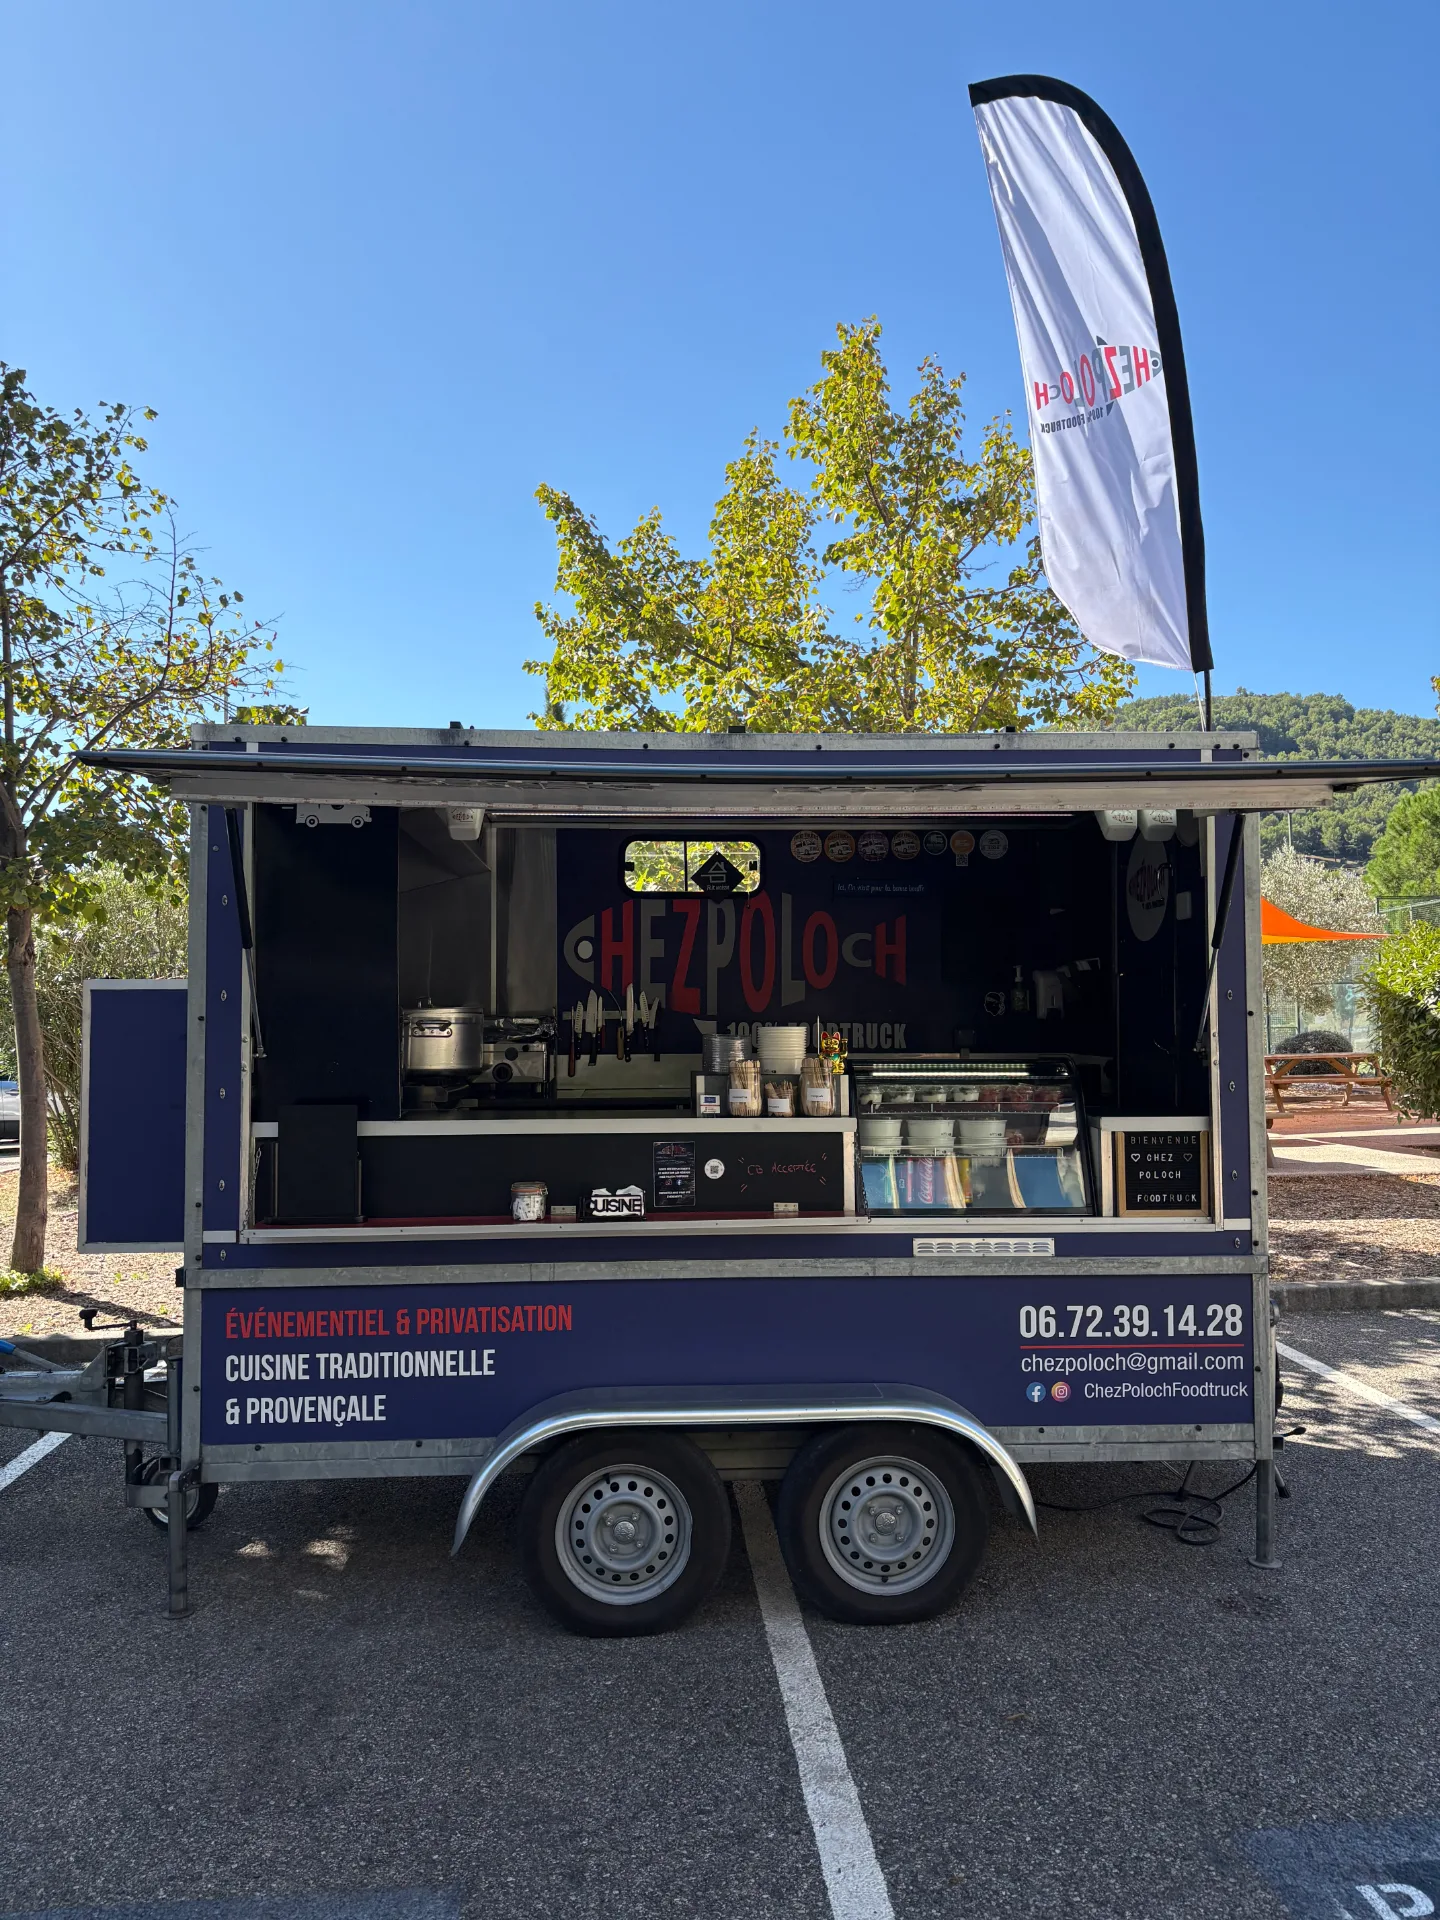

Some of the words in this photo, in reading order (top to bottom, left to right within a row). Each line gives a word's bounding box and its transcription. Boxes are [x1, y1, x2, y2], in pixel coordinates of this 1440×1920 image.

[1130, 1135, 1197, 1145] BIENVENUE
[1146, 1153, 1174, 1162] CHEZ
[747, 1164, 764, 1176] CB
[1139, 1170, 1181, 1180] POLOCH
[1137, 1194, 1197, 1203] FOODTRUCK
[225, 1307, 390, 1339] ÉVÉNEMENTIEL
[396, 1308, 411, 1336] &
[416, 1304, 573, 1335] PRIVATISATION
[1019, 1303, 1243, 1339] 06.72.39.14.28
[225, 1353, 310, 1382] CUISINE
[316, 1349, 496, 1381] TRADITIONNELLE
[1021, 1352, 1244, 1375] chezpoloch@gmail.com
[1084, 1381, 1249, 1398] ChezPolochFoodtruck
[225, 1398, 241, 1425] &
[246, 1394, 387, 1427] PROVENÇALE
